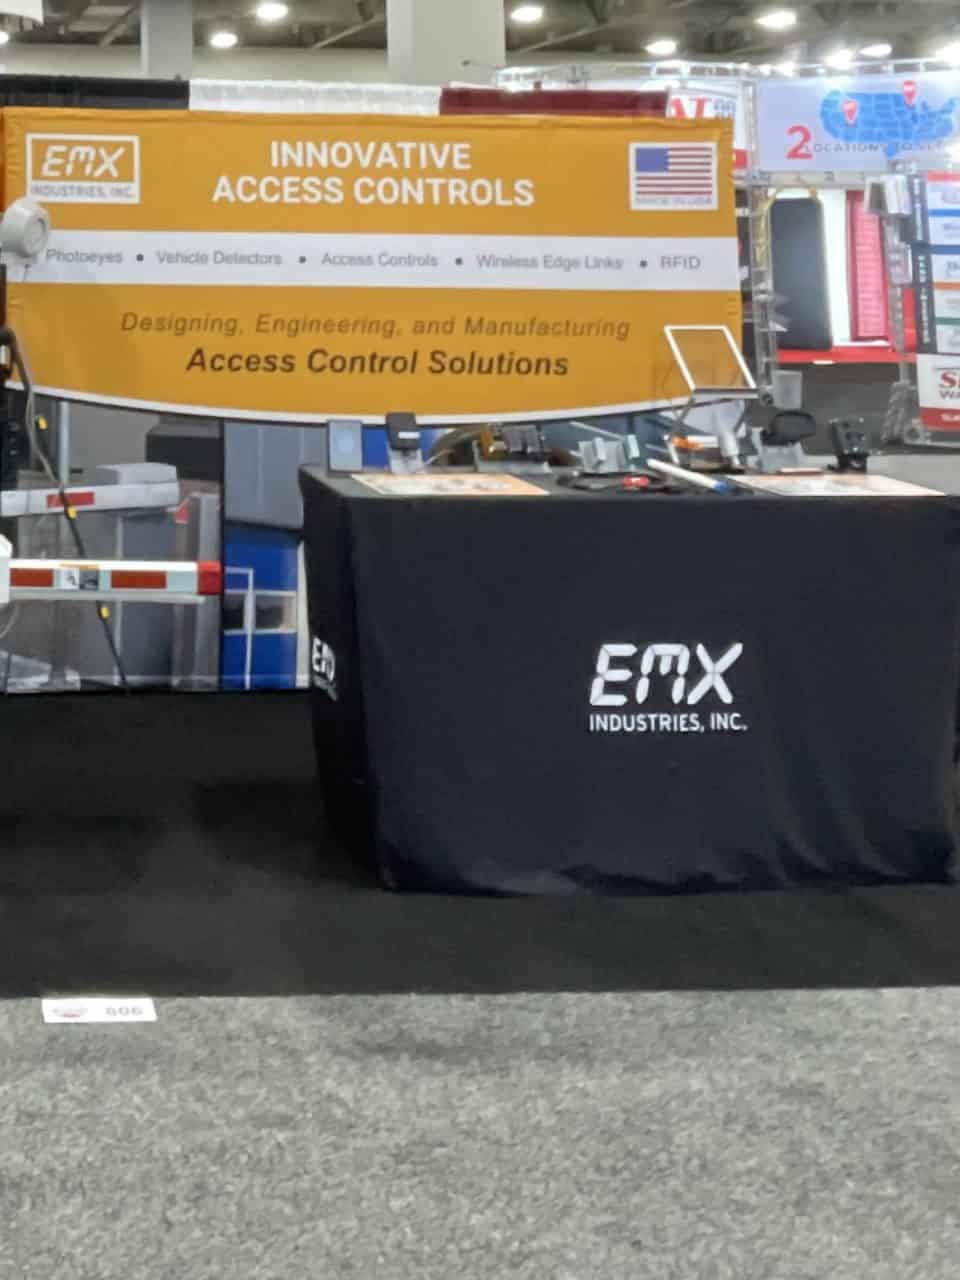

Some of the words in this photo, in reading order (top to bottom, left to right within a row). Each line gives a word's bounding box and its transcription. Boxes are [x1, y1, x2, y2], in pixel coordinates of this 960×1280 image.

[271, 140, 472, 170] INNOVATIVE
[785, 124, 813, 160] 2
[41, 144, 126, 177] EMX
[211, 176, 344, 205] ACCESS
[353, 177, 535, 207] CONTROLS
[46, 248, 123, 268] Photoeyes
[155, 250, 209, 265] Vehicle
[213, 250, 283, 266] Detectors
[321, 252, 374, 267] Access
[378, 252, 438, 268] Controls
[476, 253, 539, 269] Wireless
[543, 254, 580, 272] Edge
[584, 255, 623, 270] Links
[660, 255, 701, 270] RFID
[120, 311, 243, 337] Designing,
[255, 313, 402, 339] Engineering,
[412, 316, 455, 336] and
[464, 317, 631, 341] Manufacturing
[186, 347, 296, 373] Access
[307, 348, 418, 374] Control
[428, 350, 570, 376] Solutions
[590, 642, 744, 707] EMX
[589, 713, 705, 733] INDUSTRIES,
[710, 712, 749, 731] INC.
